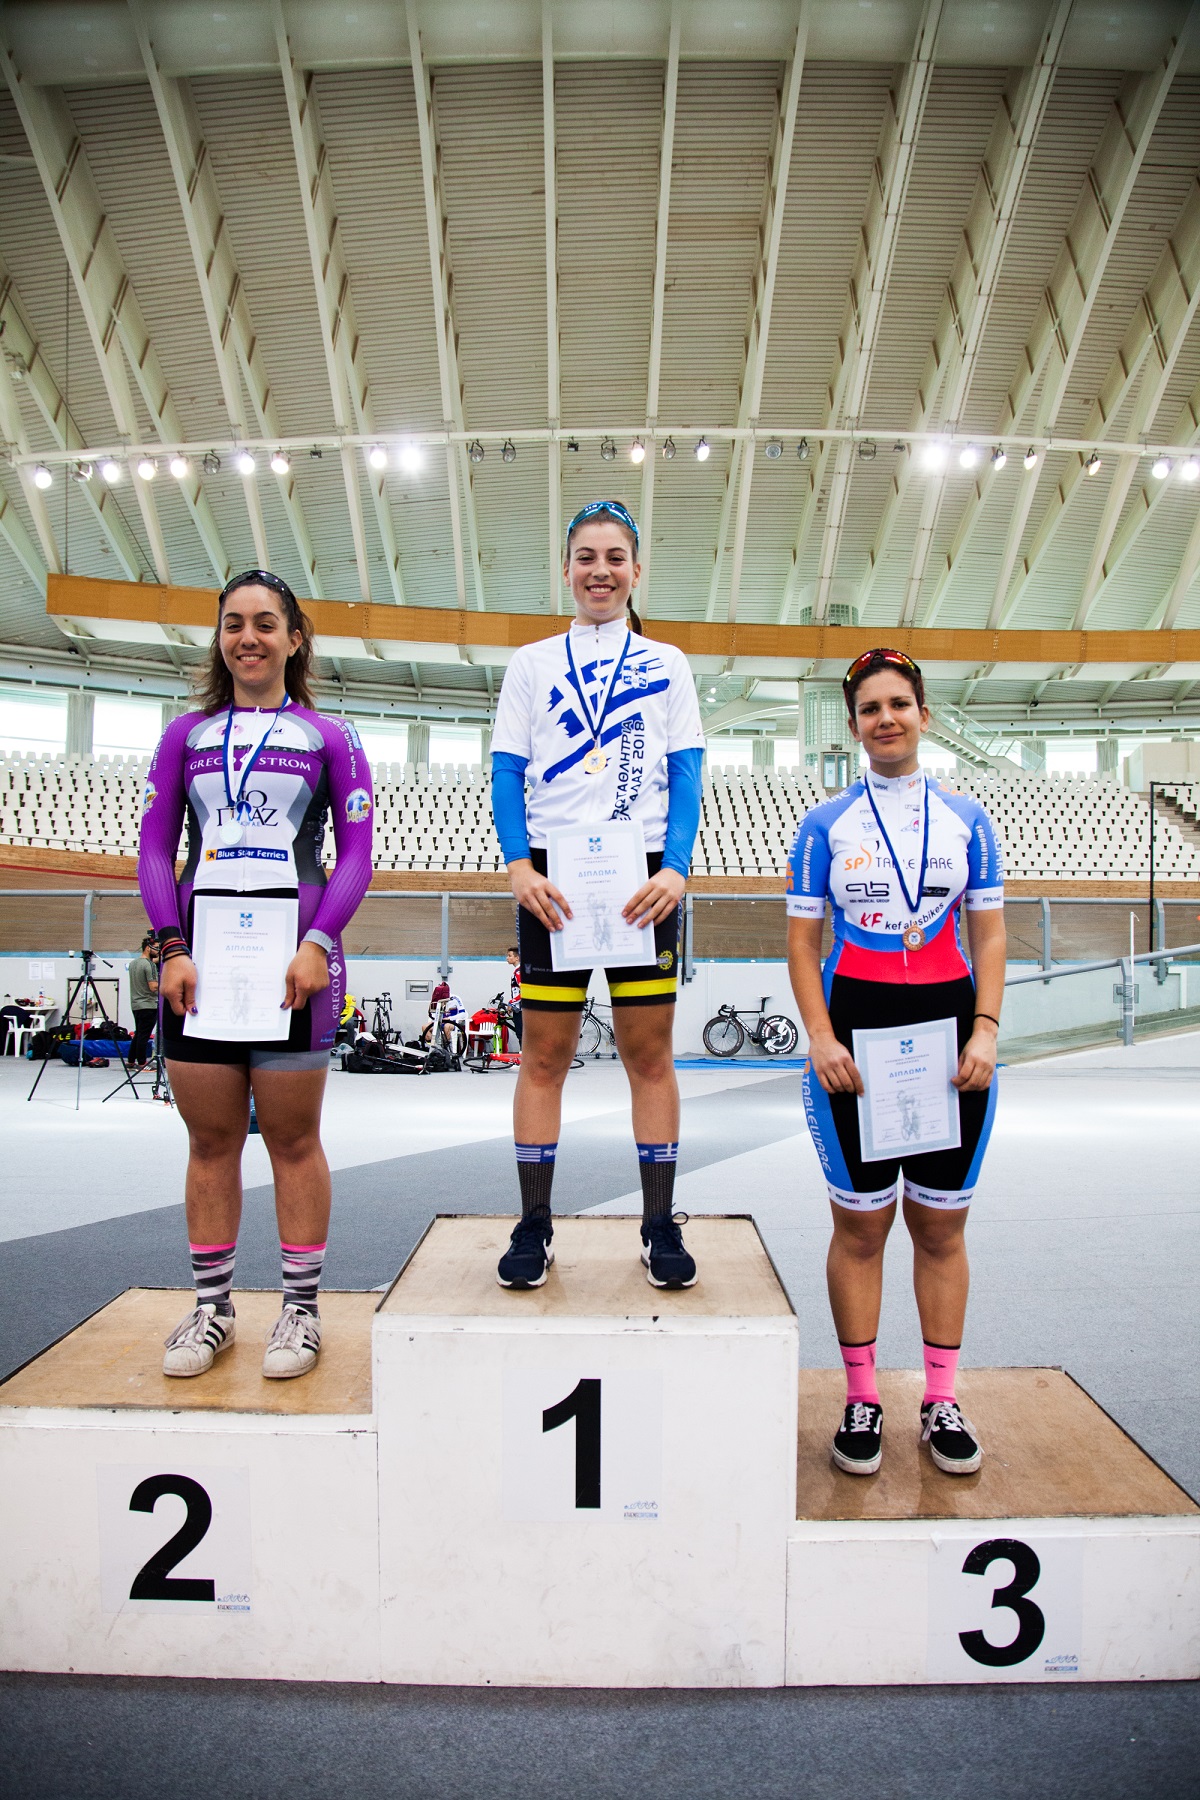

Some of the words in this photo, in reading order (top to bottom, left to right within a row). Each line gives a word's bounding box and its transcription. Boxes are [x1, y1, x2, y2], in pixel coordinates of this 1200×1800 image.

[632, 720, 645, 759] 2018
[258, 757, 311, 771] STROM
[217, 850, 235, 858] Blue
[237, 849, 255, 857] Star
[256, 850, 286, 860] Ferries
[844, 857, 865, 871] SP
[578, 869, 617, 878] ΔΙΠΛΩΜΑ
[860, 912, 884, 928] KF
[331, 979, 341, 1019] GRECO
[889, 1066, 928, 1079] ΔΙΠΛΩΜΑ
[802, 1075, 832, 1173] TABLEWARE
[542, 1379, 601, 1509] 1
[129, 1474, 215, 1601] 2
[958, 1539, 1045, 1667] 3
